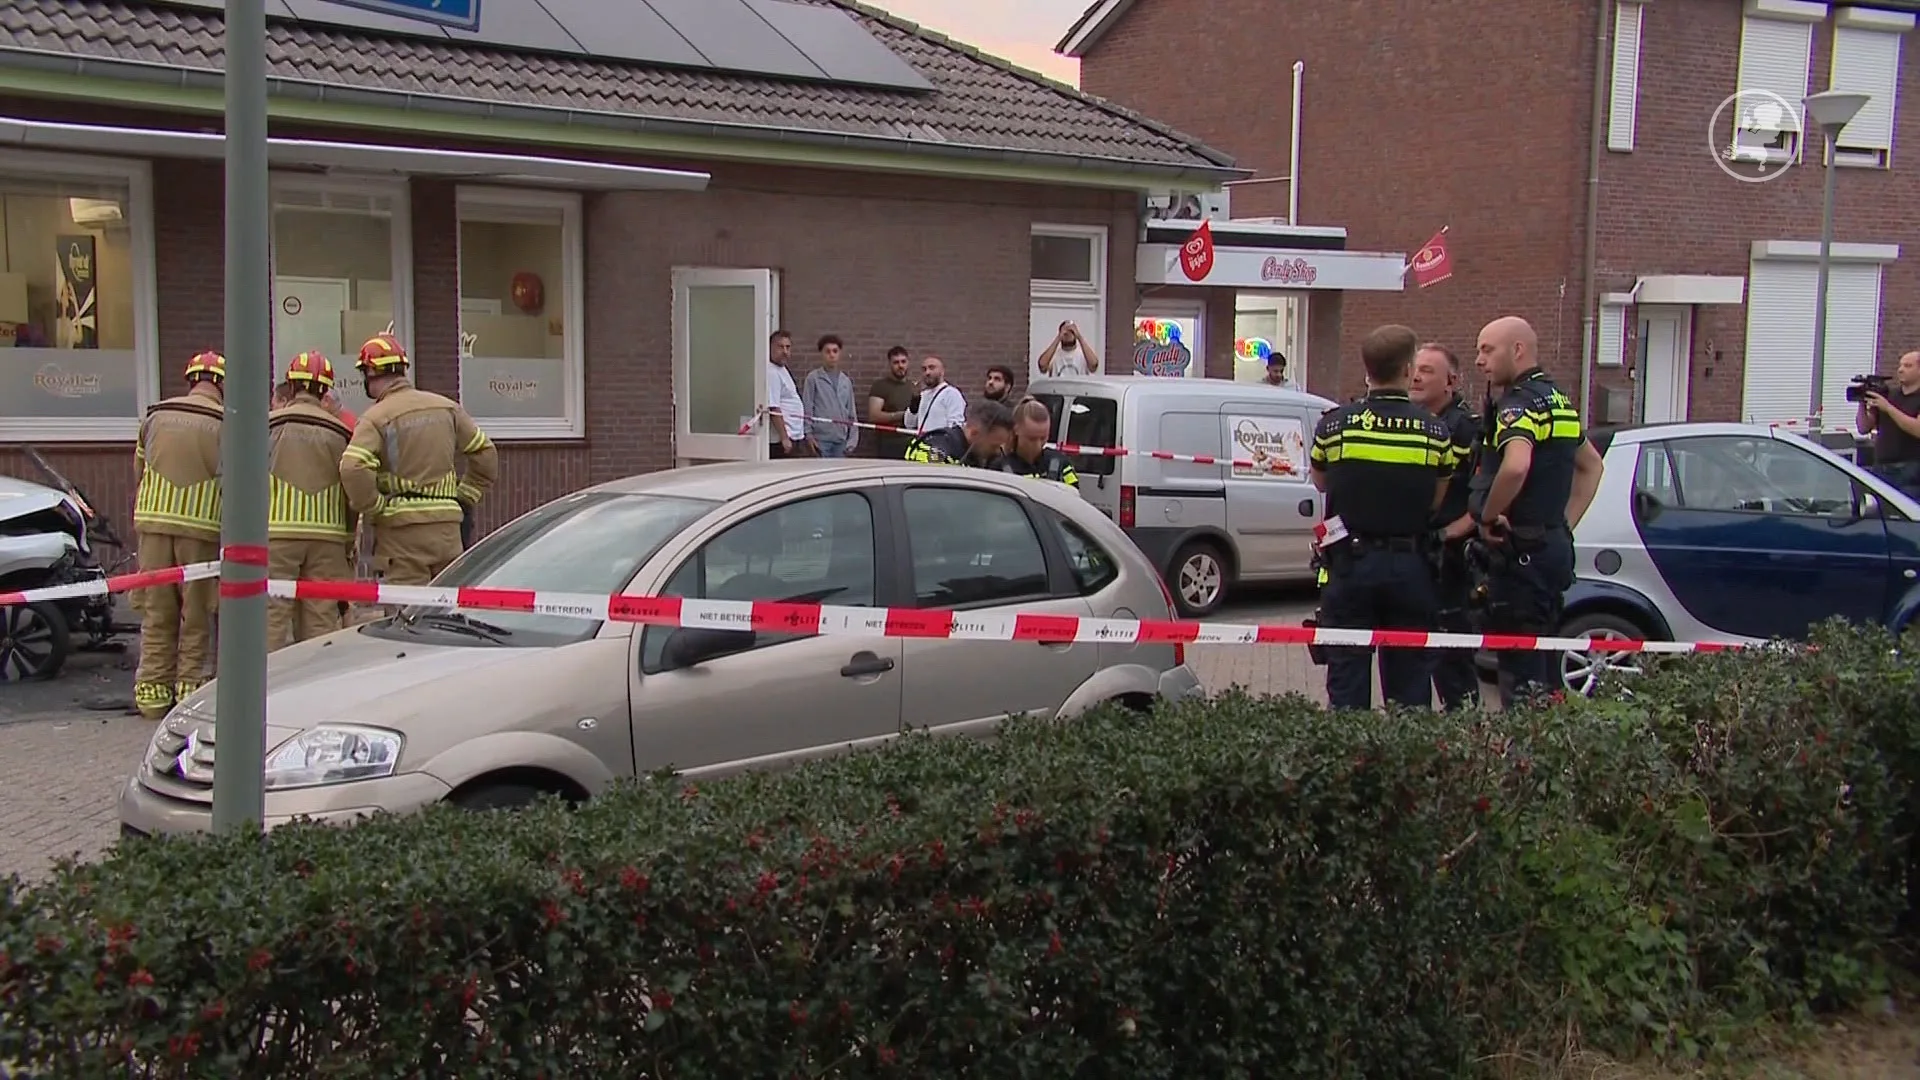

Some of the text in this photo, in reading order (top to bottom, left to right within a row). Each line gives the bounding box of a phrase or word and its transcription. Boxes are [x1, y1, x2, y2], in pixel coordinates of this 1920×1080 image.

[1261, 256, 1317, 285] Candy Shop
[1134, 342, 1187, 369] Candy
[34, 374, 80, 390] Royal
[489, 380, 522, 396] Royal
[1233, 429, 1269, 446] Royal
[545, 604, 593, 614] BETREDEN
[700, 612, 719, 621] NIET
[720, 613, 764, 624] BETREDEN
[865, 620, 882, 628] NIET
